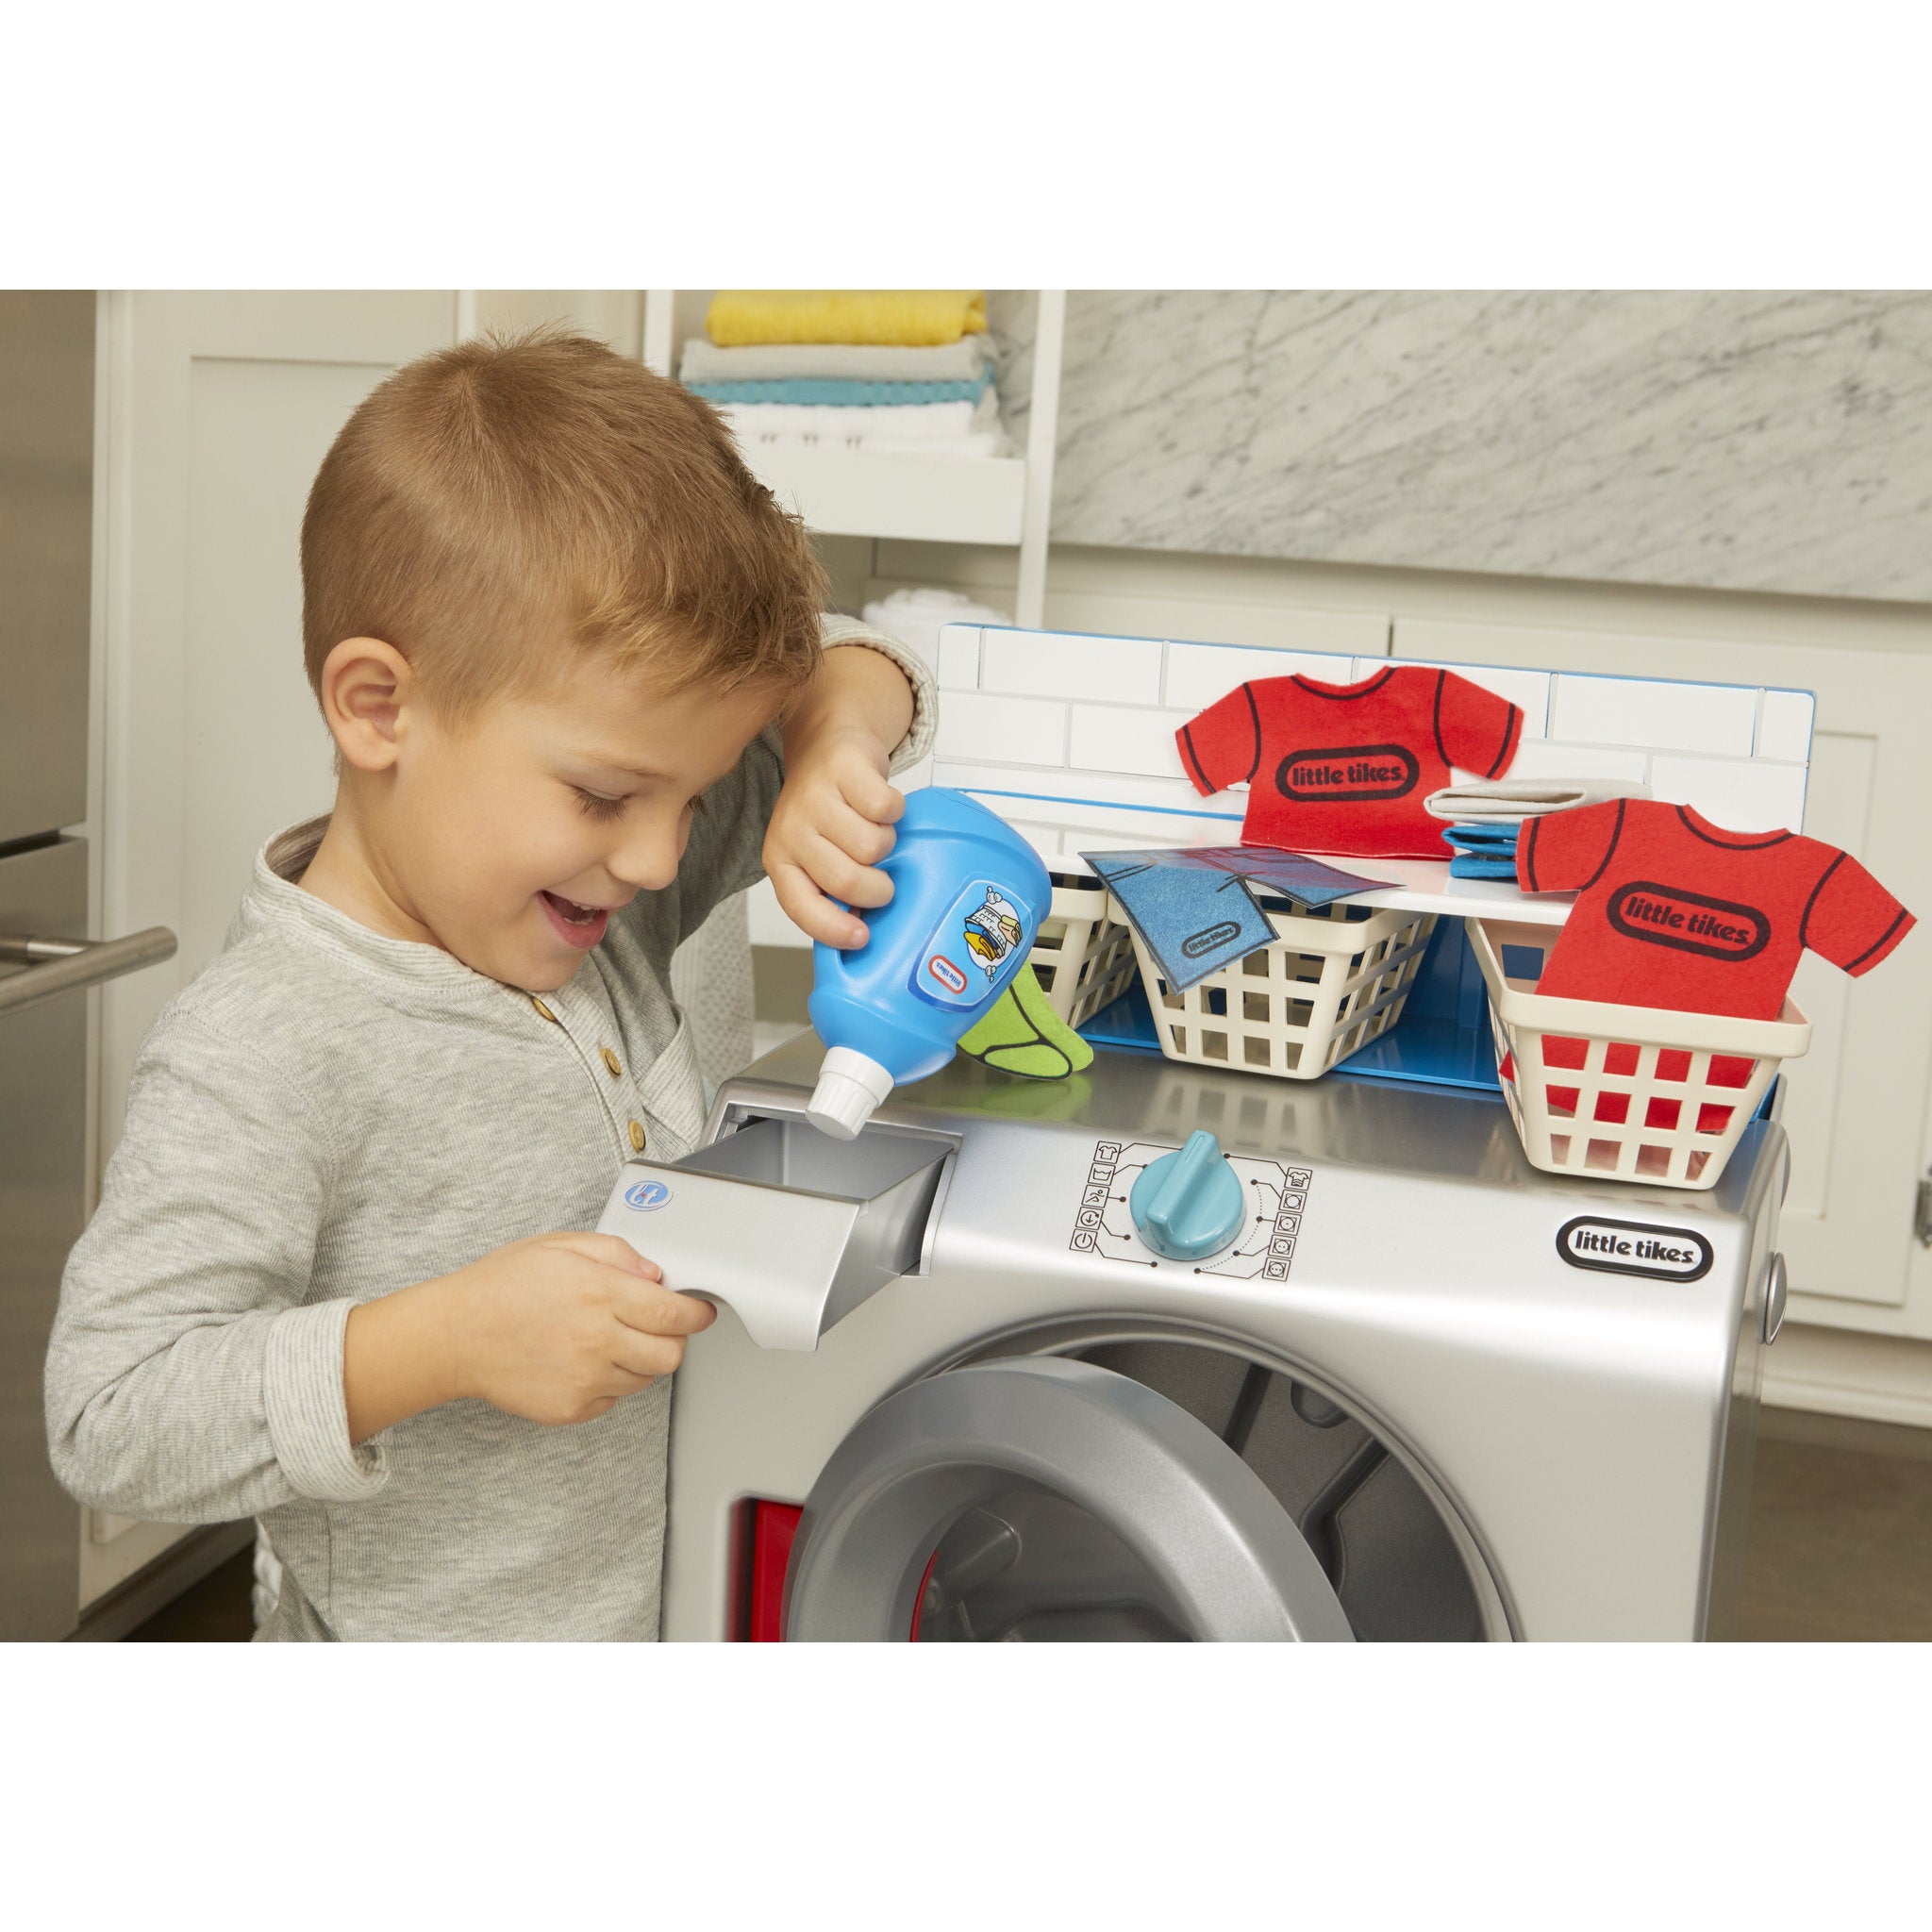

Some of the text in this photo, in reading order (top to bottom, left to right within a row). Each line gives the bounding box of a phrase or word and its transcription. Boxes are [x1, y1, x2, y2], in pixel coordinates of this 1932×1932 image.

[1293, 763, 1402, 786] little tikes
[1625, 896, 1750, 944] little tikes
[936, 961, 961, 987] little tikes
[1574, 1230, 1694, 1264] little tikes
